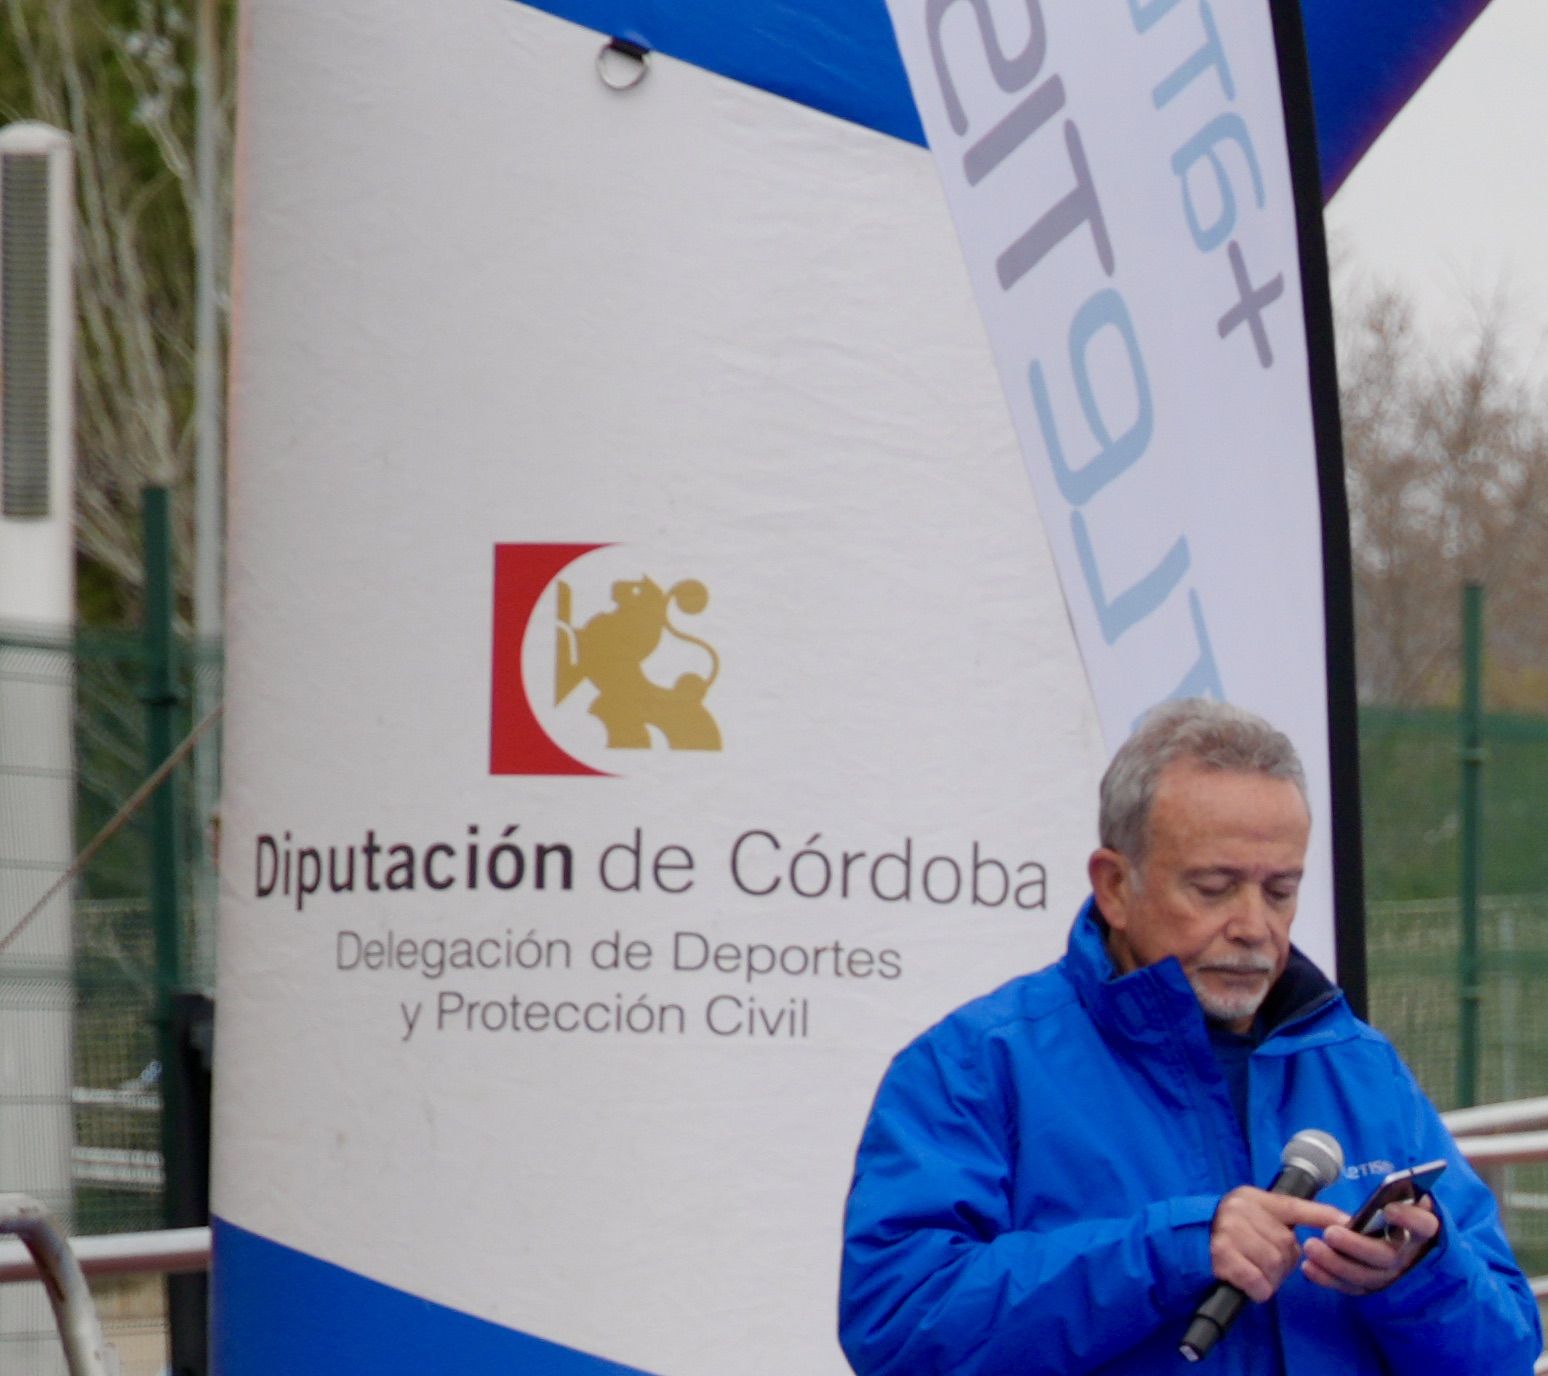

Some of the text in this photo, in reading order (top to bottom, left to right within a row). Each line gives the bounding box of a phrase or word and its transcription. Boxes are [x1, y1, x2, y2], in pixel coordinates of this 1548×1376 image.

[253, 823, 1050, 913] Diputación de Córdoba
[336, 928, 904, 983] Delegación de Deportes
[400, 990, 809, 1042] y Protección Civil
